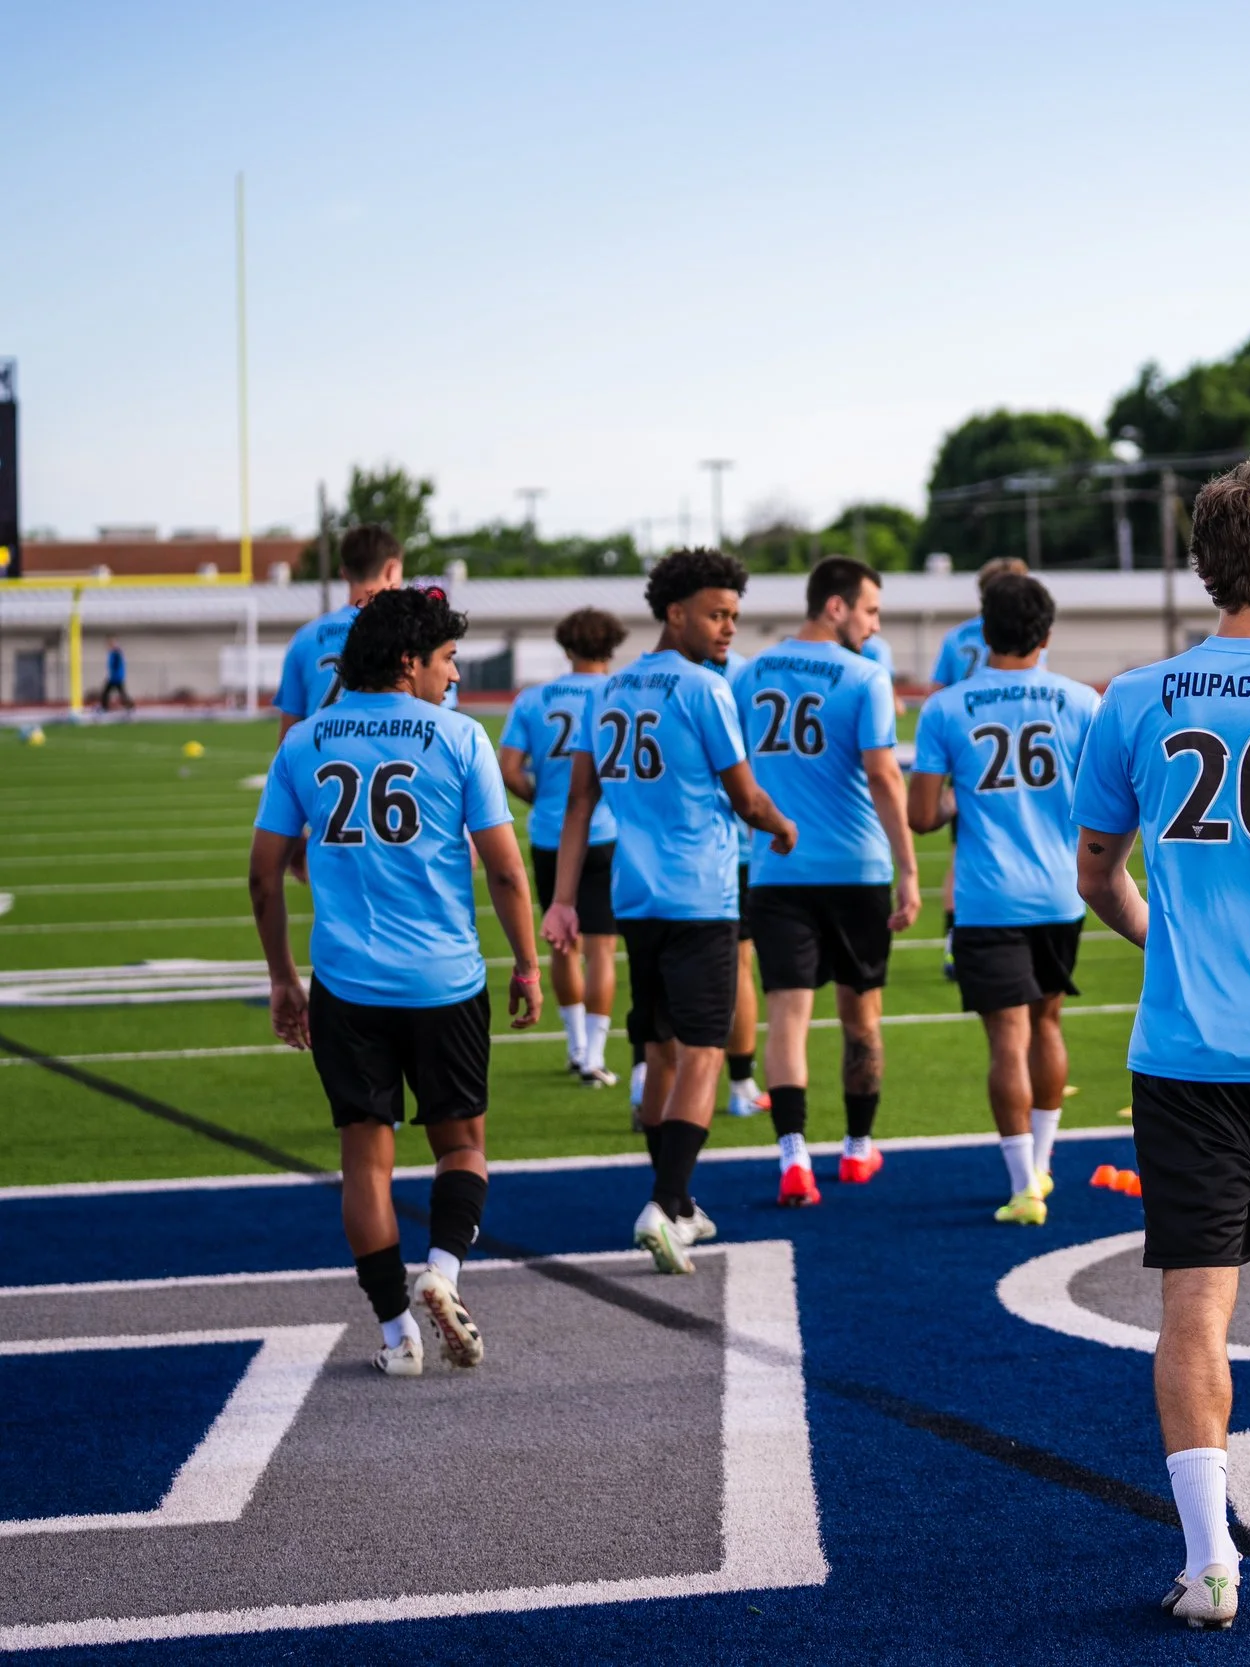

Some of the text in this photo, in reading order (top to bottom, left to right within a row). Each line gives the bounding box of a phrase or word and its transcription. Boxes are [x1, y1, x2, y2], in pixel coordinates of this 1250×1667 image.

[316, 652, 345, 709] 2
[960, 644, 983, 679] 2
[313, 719, 436, 753] CHUPACABRAS
[543, 708, 573, 760] 2
[599, 707, 666, 782] 26
[751, 687, 828, 759] 26
[968, 720, 1059, 795] 26
[314, 759, 423, 847] 26
